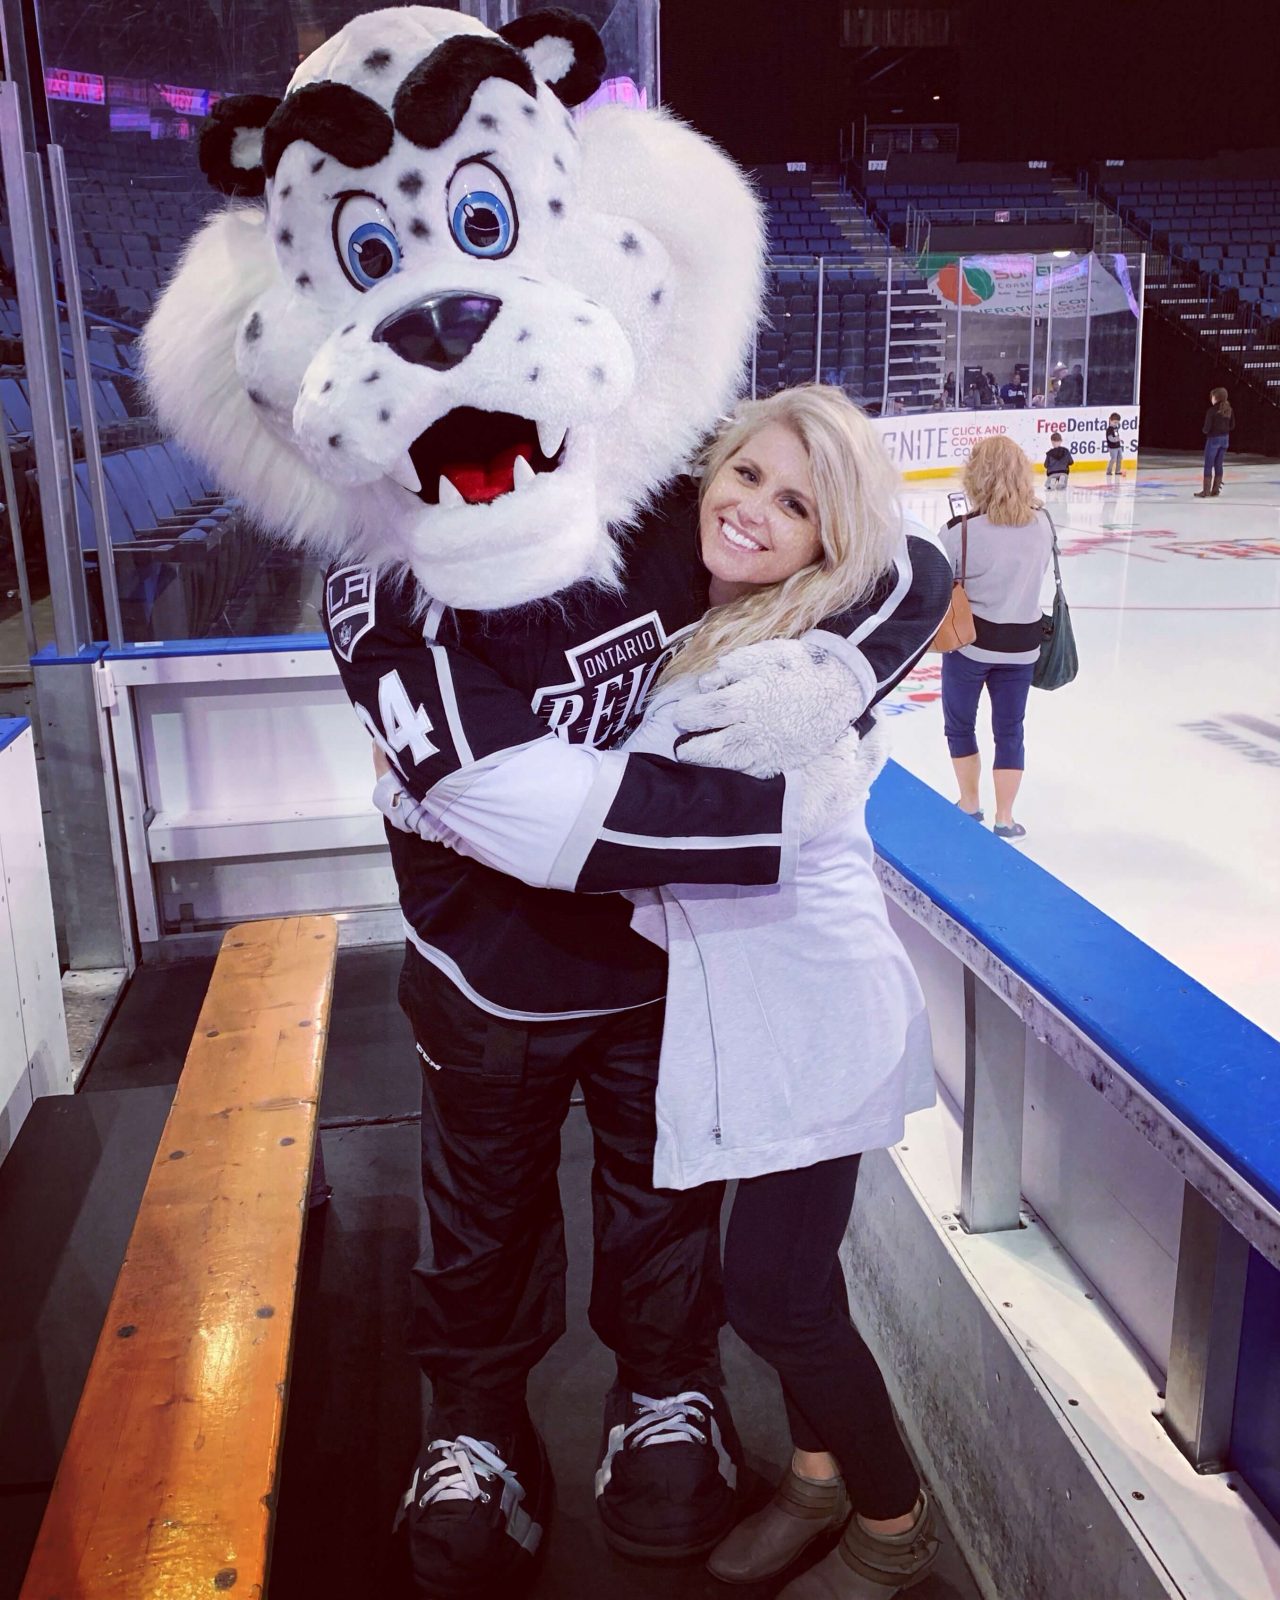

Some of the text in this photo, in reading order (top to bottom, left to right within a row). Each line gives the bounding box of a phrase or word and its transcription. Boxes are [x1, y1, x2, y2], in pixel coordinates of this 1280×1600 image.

[951, 424, 1007, 437] CLICK AND
[329, 573, 369, 610] LA
[583, 630, 655, 679] ONTARIO
